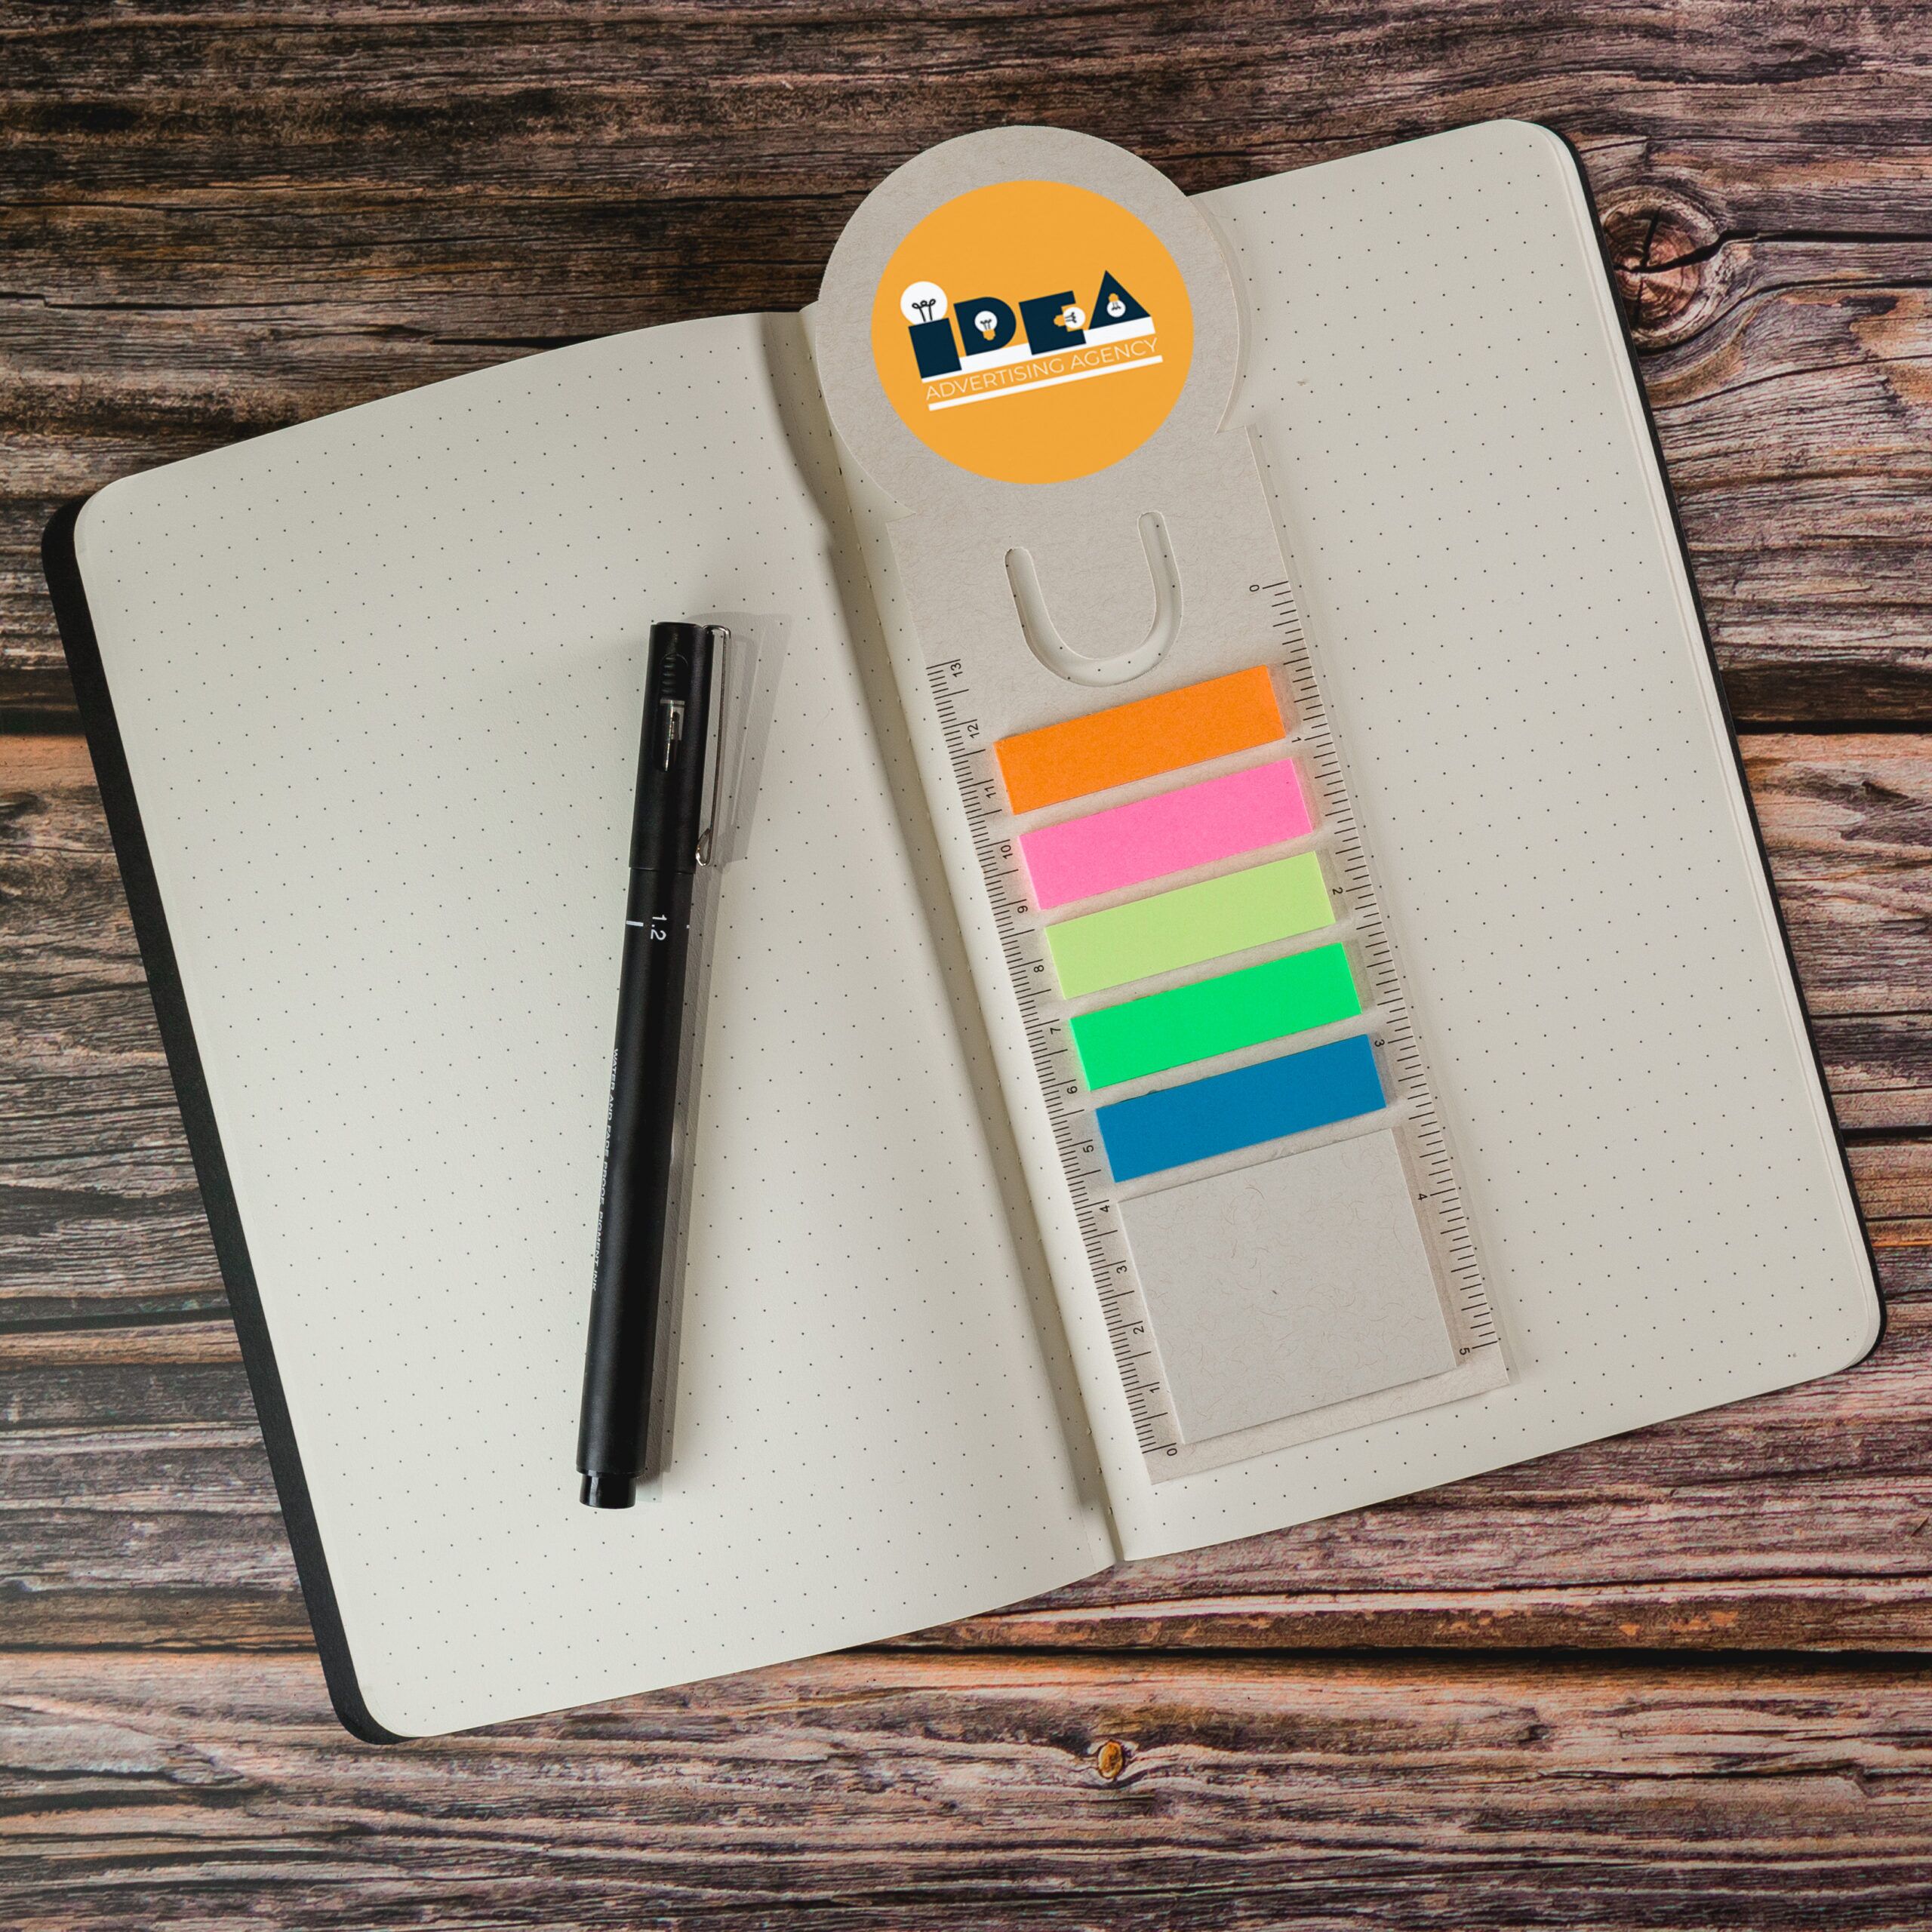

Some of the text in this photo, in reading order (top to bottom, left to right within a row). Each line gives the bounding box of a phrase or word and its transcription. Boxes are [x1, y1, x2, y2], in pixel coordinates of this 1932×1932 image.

[926, 337, 1158, 400] ADVERTISING AGENCY
[1249, 584, 1260, 592] 0
[950, 662, 963, 678] 13
[968, 723, 980, 739] 12
[984, 786, 996, 799] 11
[1001, 844, 1013, 860] 10
[1332, 887, 1343, 896] 2
[1017, 905, 1029, 914] 9
[651, 914, 667, 941] 1.2
[1033, 964, 1044, 974] 8
[1050, 1027, 1061, 1035] 7
[1374, 1038, 1386, 1048] 3
[610, 1048, 619, 1091] WATER
[1066, 1085, 1078, 1094] 6
[1083, 1144, 1094, 1153] 5
[1417, 1192, 1429, 1201] 4
[1100, 1204, 1110, 1214] 4
[595, 1211, 604, 1267] PIGMENT
[1116, 1265, 1128, 1275] 3
[1133, 1325, 1145, 1335] 2
[1459, 1347, 1471, 1356] 5
[1167, 1447, 1178, 1457] 0
